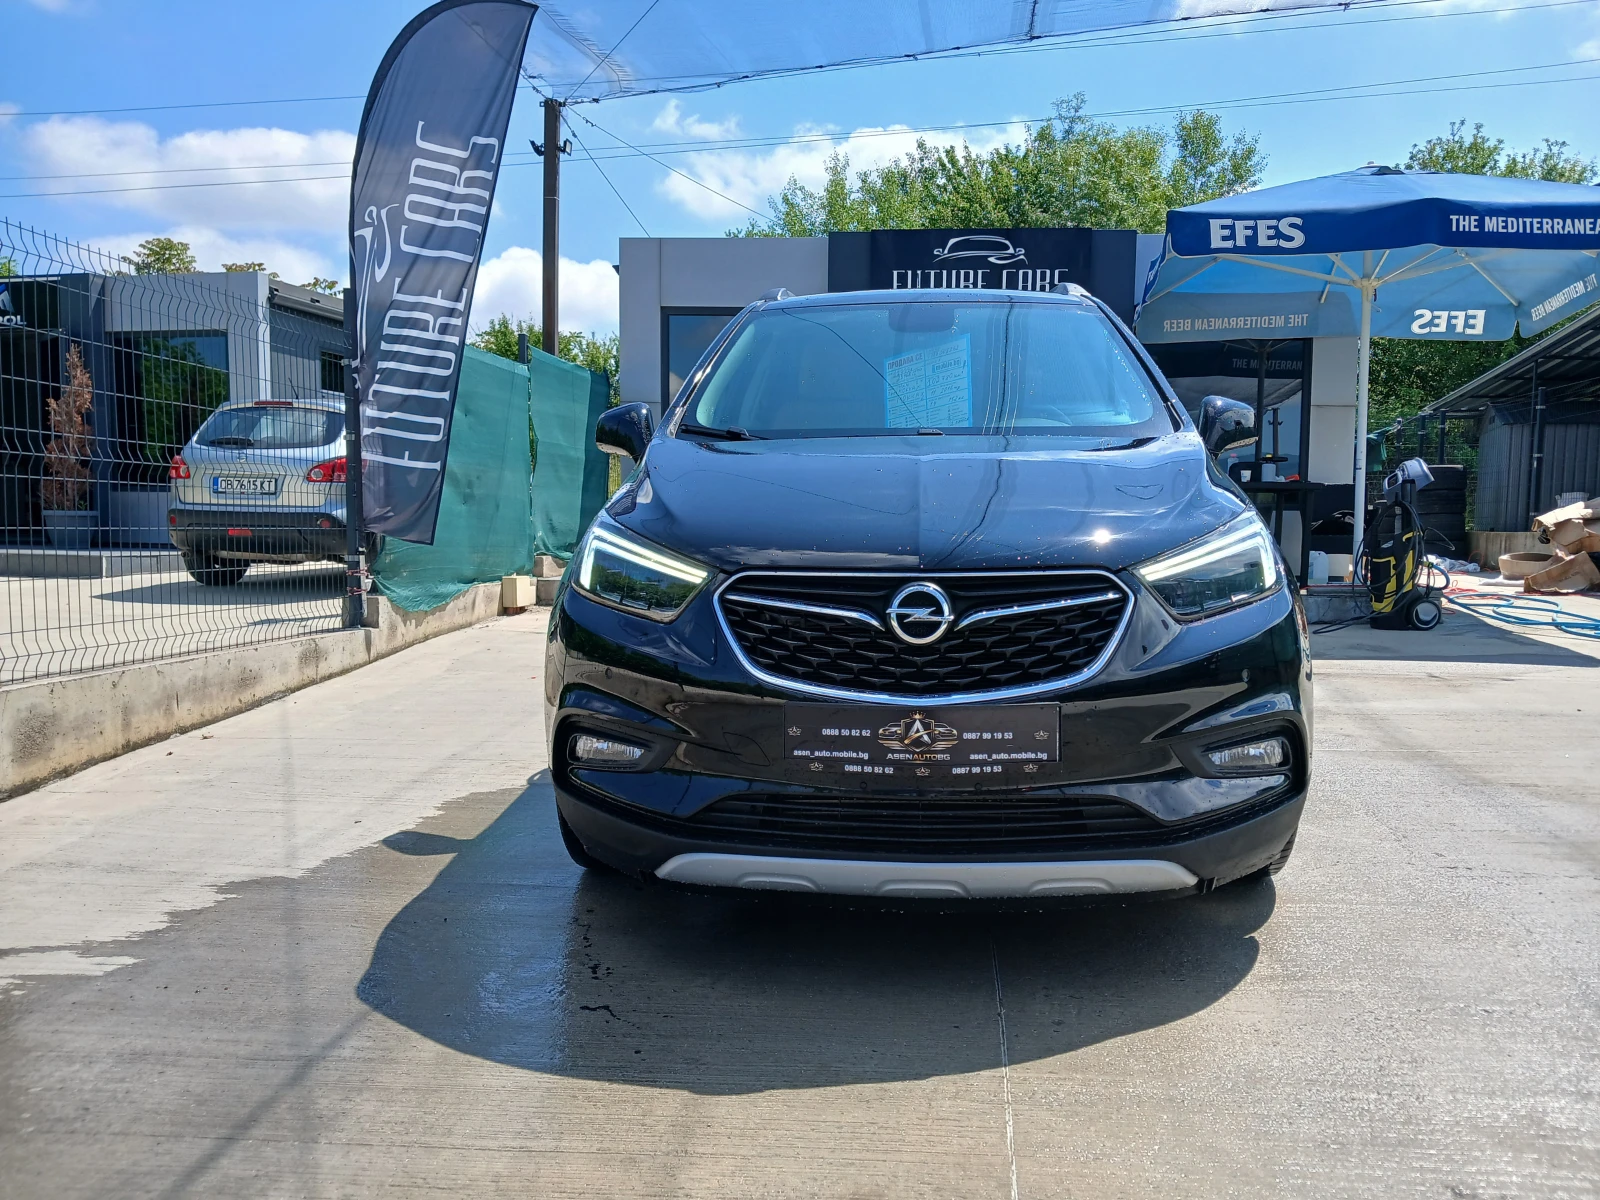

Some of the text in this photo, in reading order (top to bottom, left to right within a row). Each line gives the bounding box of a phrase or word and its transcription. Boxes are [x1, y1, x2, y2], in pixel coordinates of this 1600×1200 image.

[1450, 215, 1480, 232] THE
[1208, 217, 1306, 249] EFES
[361, 120, 499, 472] FUTURE CARS
[821, 728, 871, 737] 0888 50 82 62
[963, 732, 1013, 740] 0887 99 19 53
[844, 764, 894, 774] 0888 50 82 62
[952, 765, 1002, 775] 0887 99 19 53
